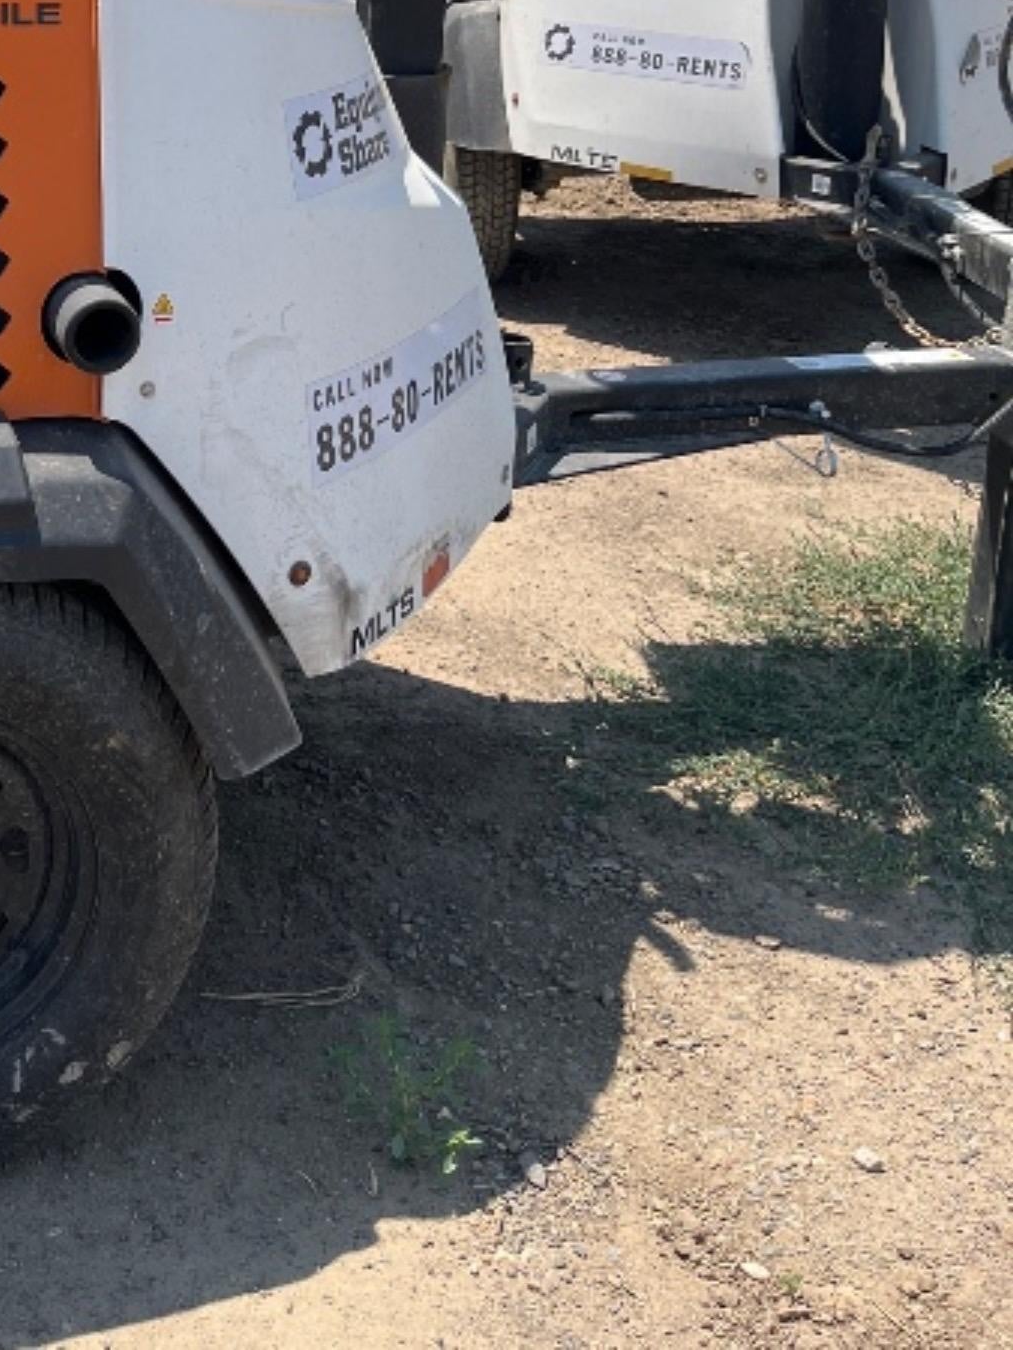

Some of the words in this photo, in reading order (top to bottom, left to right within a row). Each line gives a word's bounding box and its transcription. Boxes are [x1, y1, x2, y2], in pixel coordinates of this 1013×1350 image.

[313, 377, 356, 412] CALL
[361, 356, 393, 390] NOW
[316, 329, 485, 472] 888-80-RENTS
[352, 585, 414, 656] MLTS
